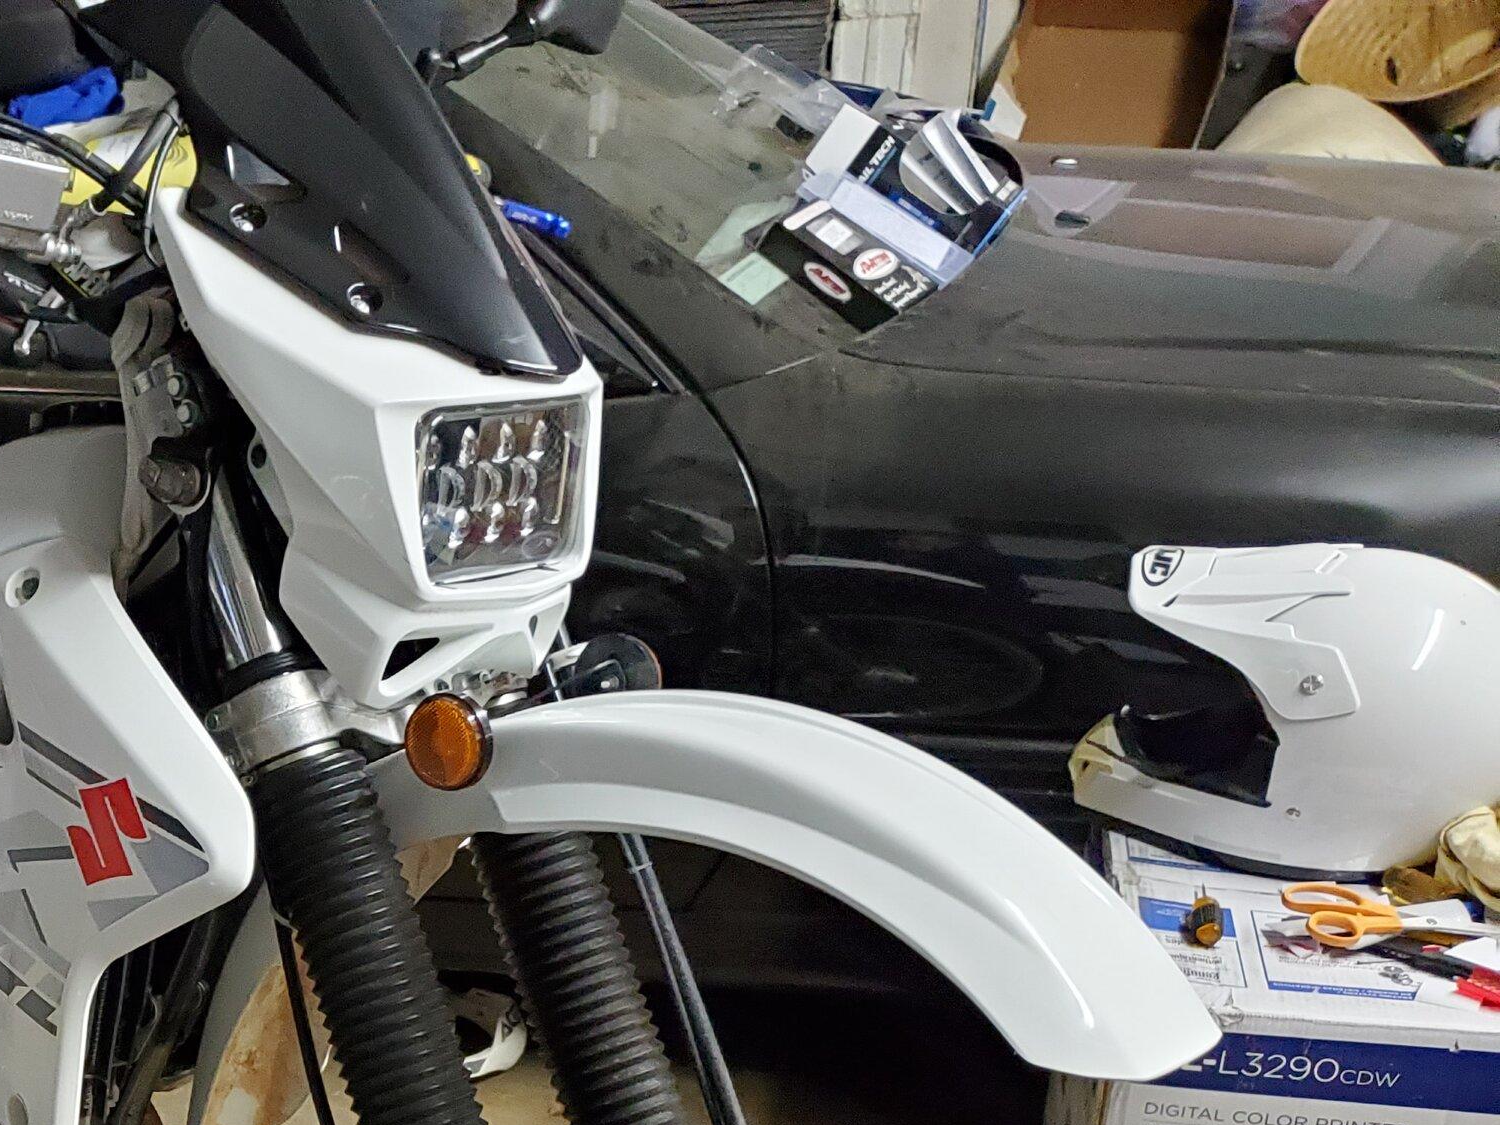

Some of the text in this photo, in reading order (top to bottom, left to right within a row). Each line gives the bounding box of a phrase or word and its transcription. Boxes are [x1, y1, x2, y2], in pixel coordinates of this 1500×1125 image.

[869, 134, 896, 167] TECH
[1180, 1049, 1401, 1089] -L3290CDW
[1143, 1101, 1225, 1123] DIGITAL
